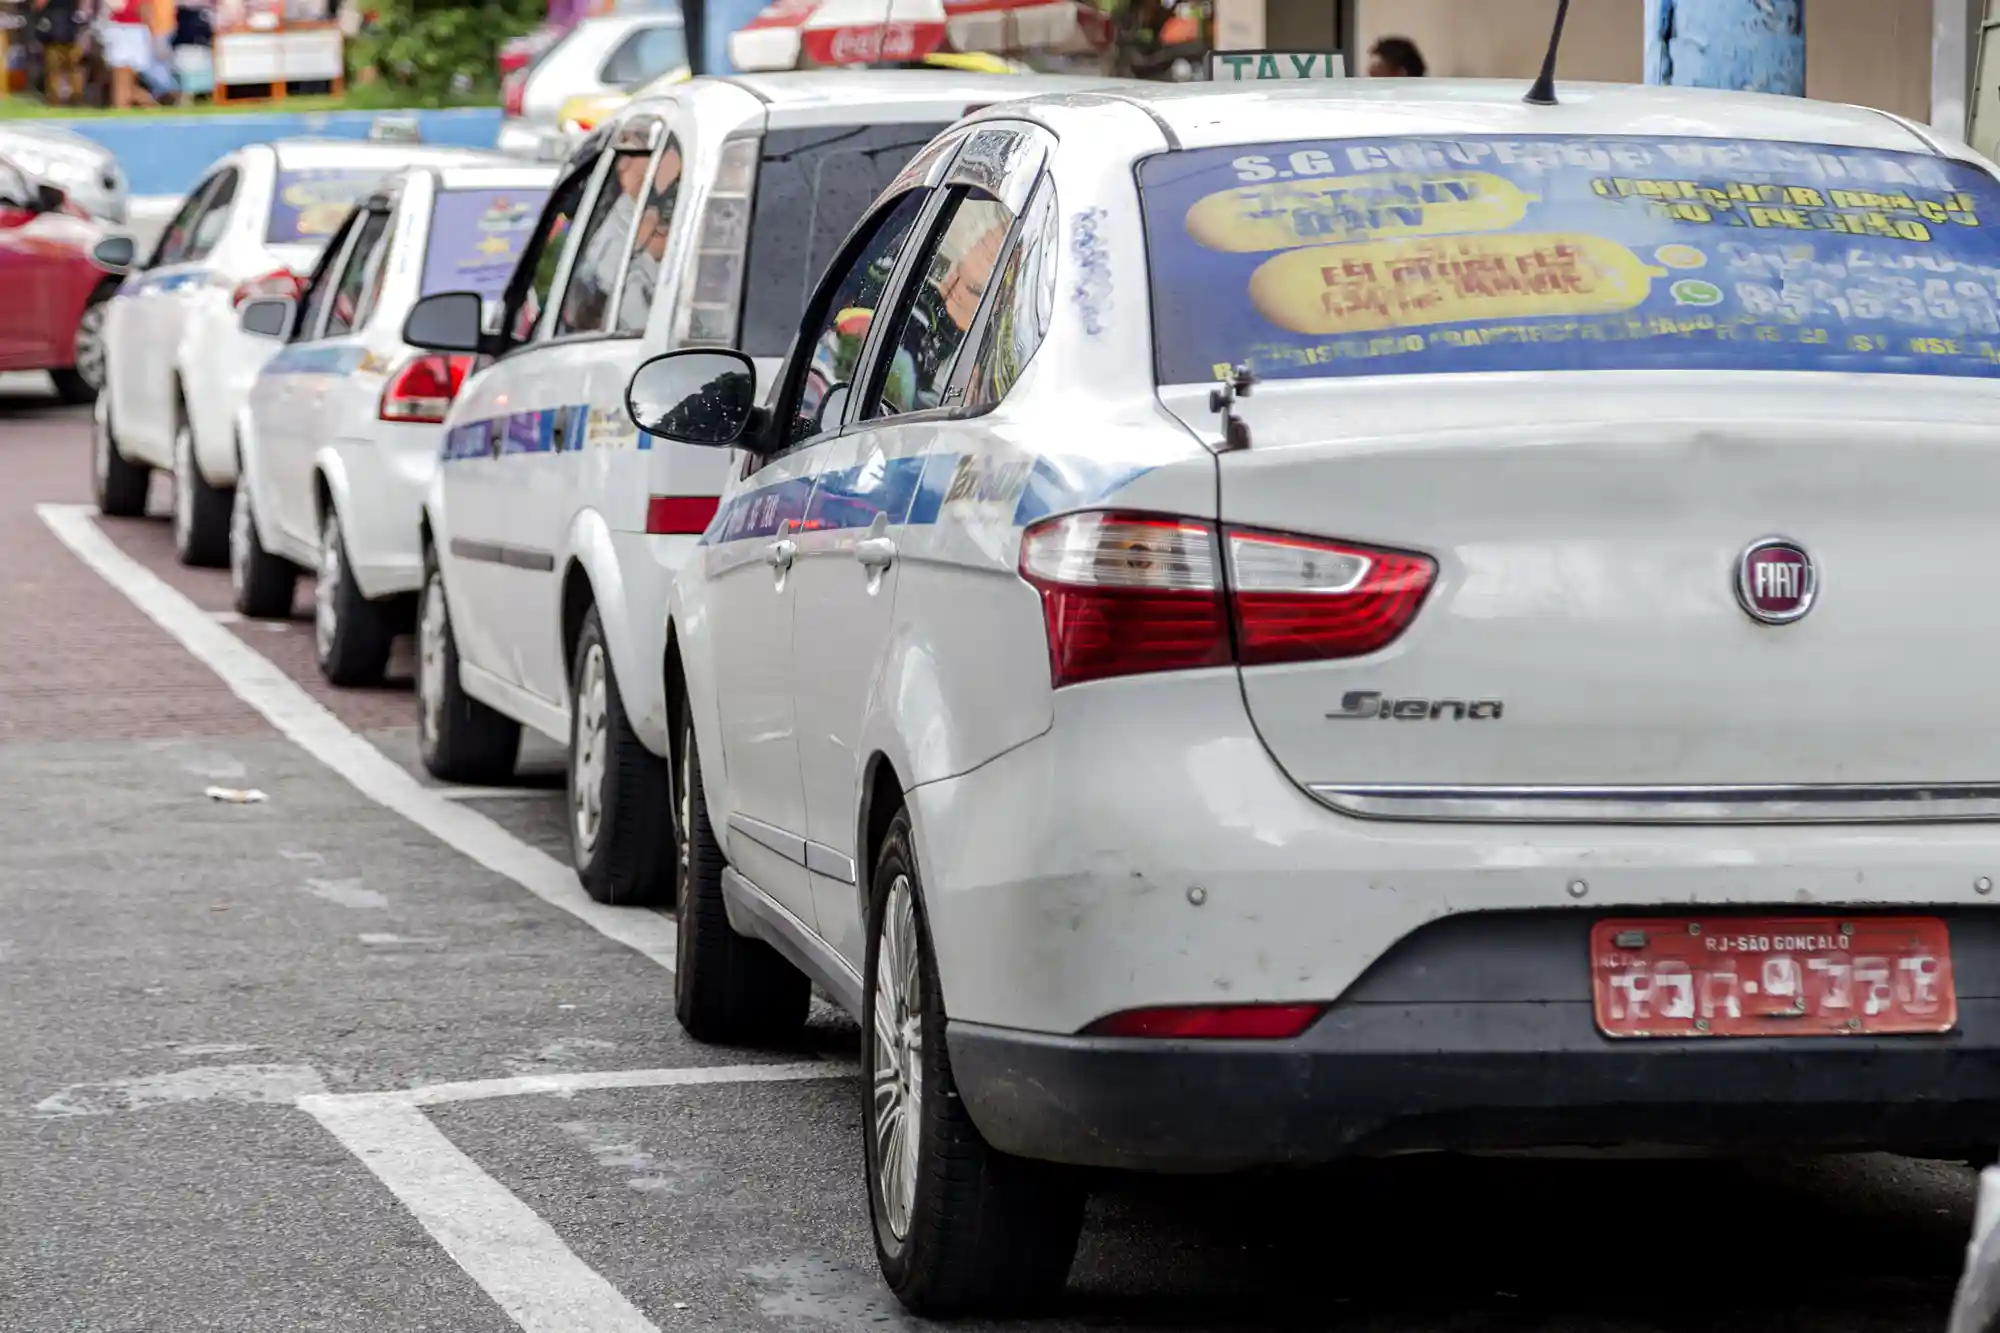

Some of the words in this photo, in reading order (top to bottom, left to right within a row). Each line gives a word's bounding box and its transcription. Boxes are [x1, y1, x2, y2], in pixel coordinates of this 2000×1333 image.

[1221, 54, 1333, 80] TAXI
[1756, 562, 1803, 598] FIAT
[1325, 690, 1504, 720] Siena
[1774, 935, 1850, 951] GONÇALO
